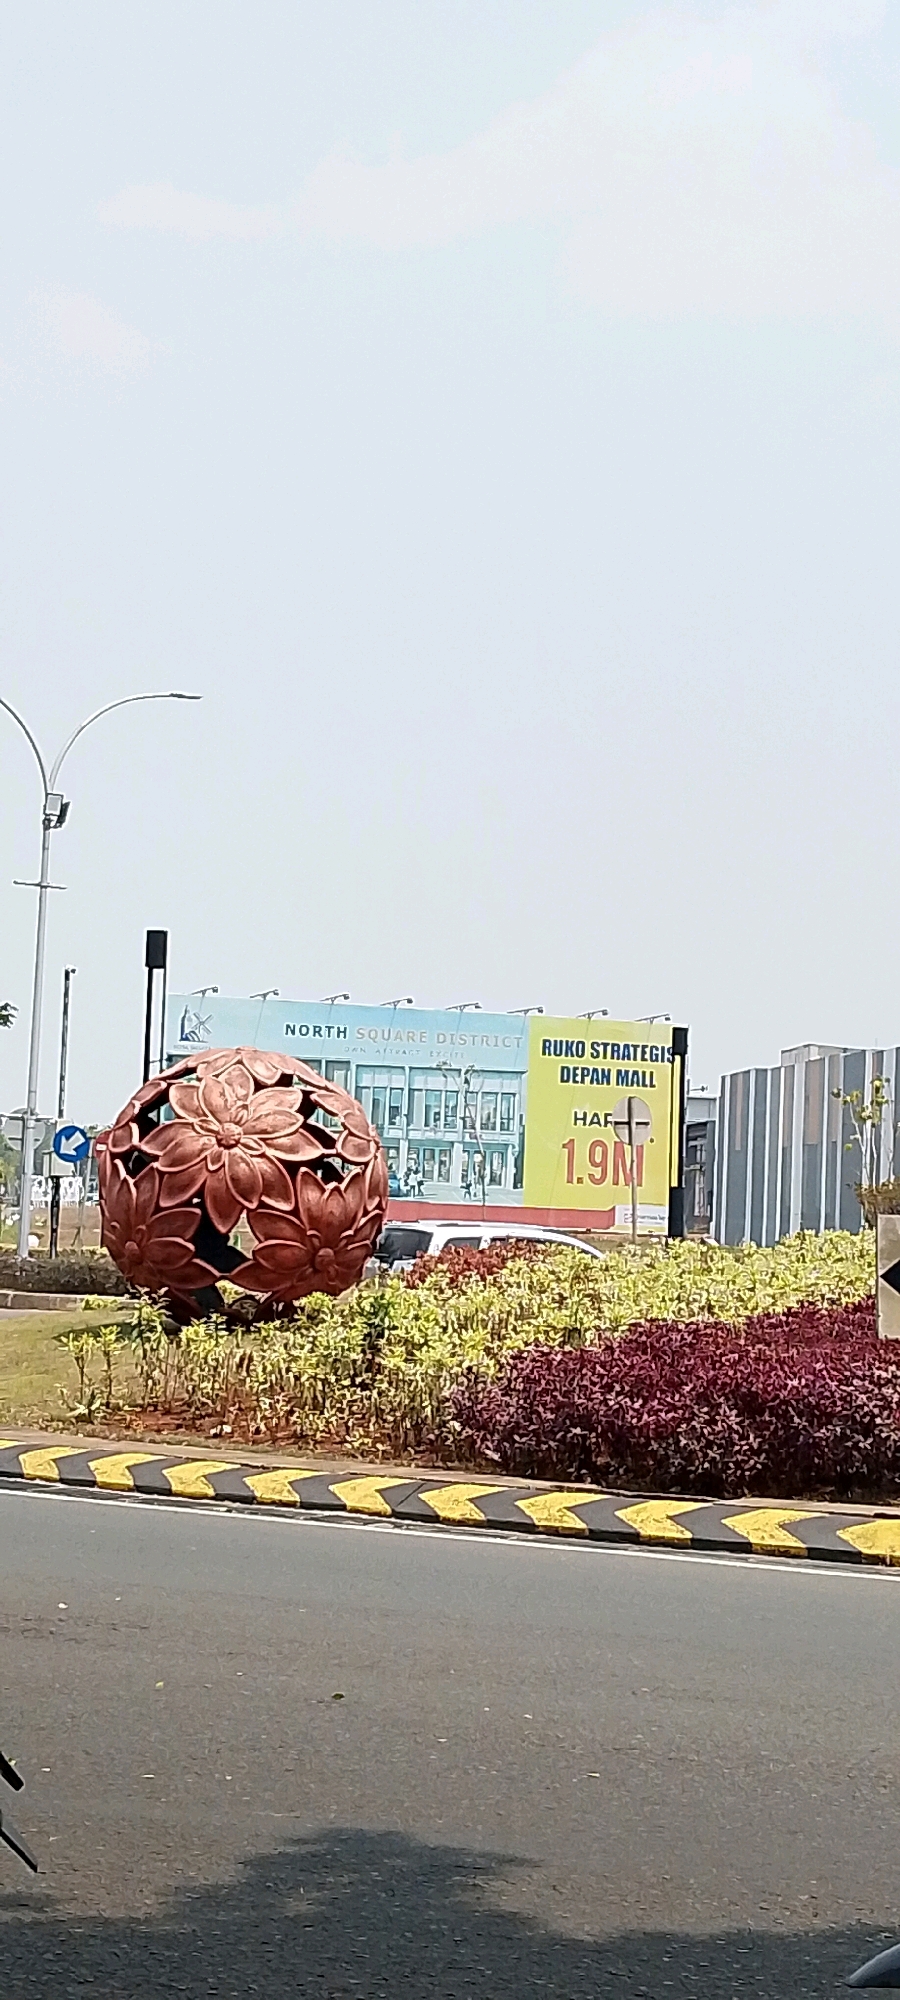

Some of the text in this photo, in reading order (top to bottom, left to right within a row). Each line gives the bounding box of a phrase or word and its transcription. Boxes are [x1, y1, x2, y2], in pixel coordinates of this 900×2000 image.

[284, 1023, 524, 1049] NORTH SQUARE DISTRICT
[541, 1038, 586, 1059] RUKO
[560, 1065, 657, 1089] DEPAN MALL
[573, 1110, 614, 1128] HAR
[561, 1138, 645, 1187] 1.9M
